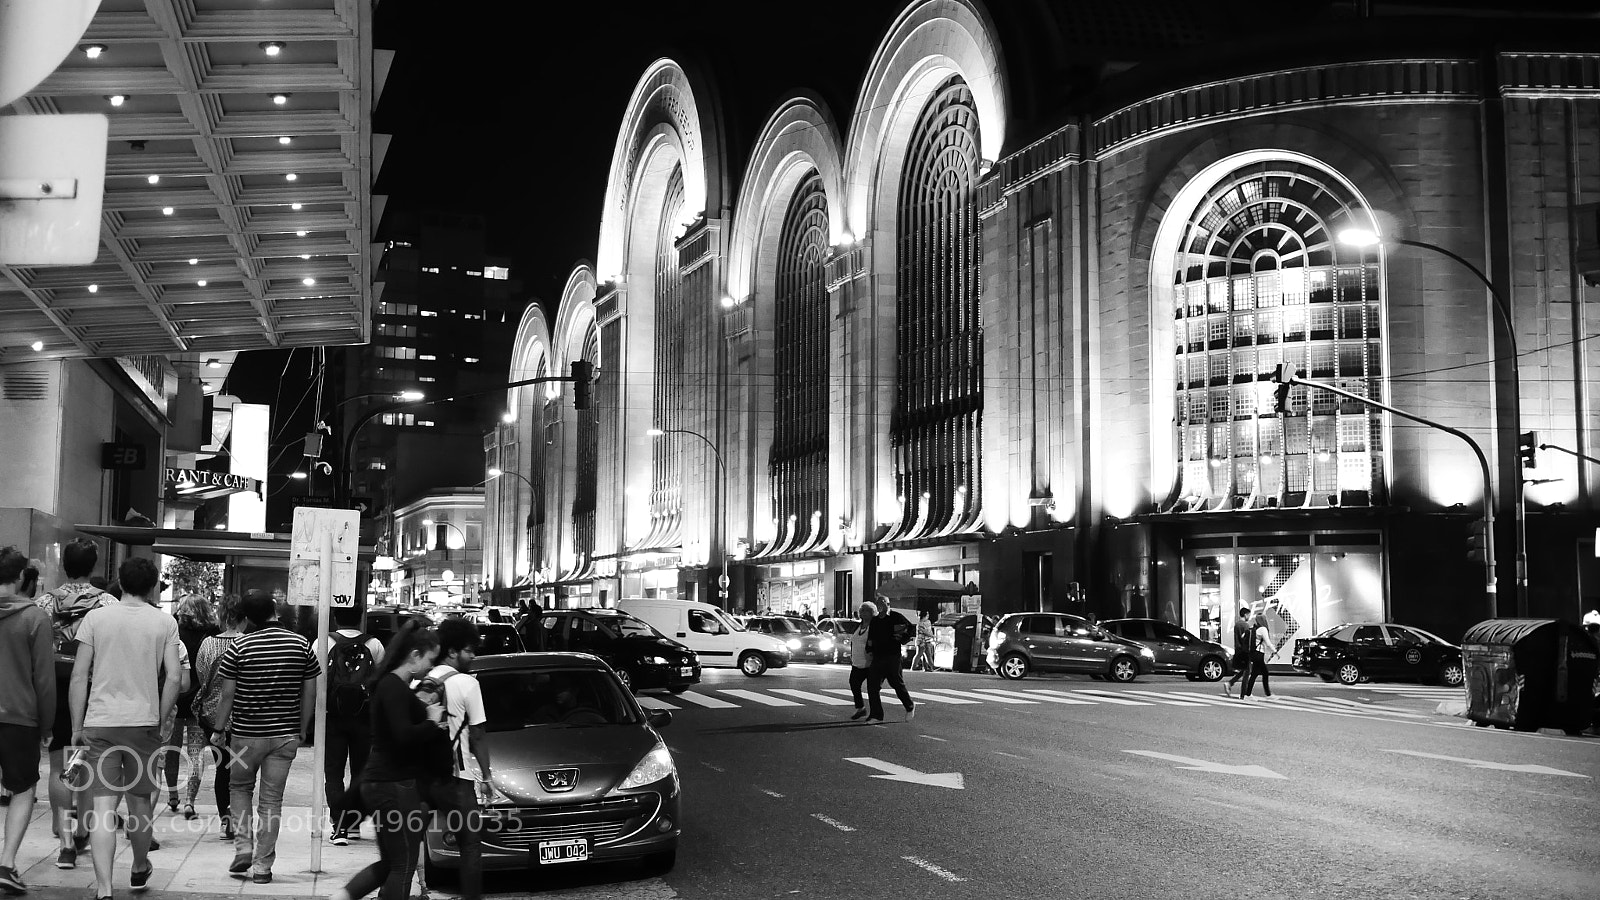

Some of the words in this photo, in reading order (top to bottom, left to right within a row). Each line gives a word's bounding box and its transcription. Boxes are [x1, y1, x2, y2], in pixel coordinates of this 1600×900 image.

[165, 468, 210, 484] RANT
[211, 472, 222, 486] &
[542, 847, 561, 860] JWU
